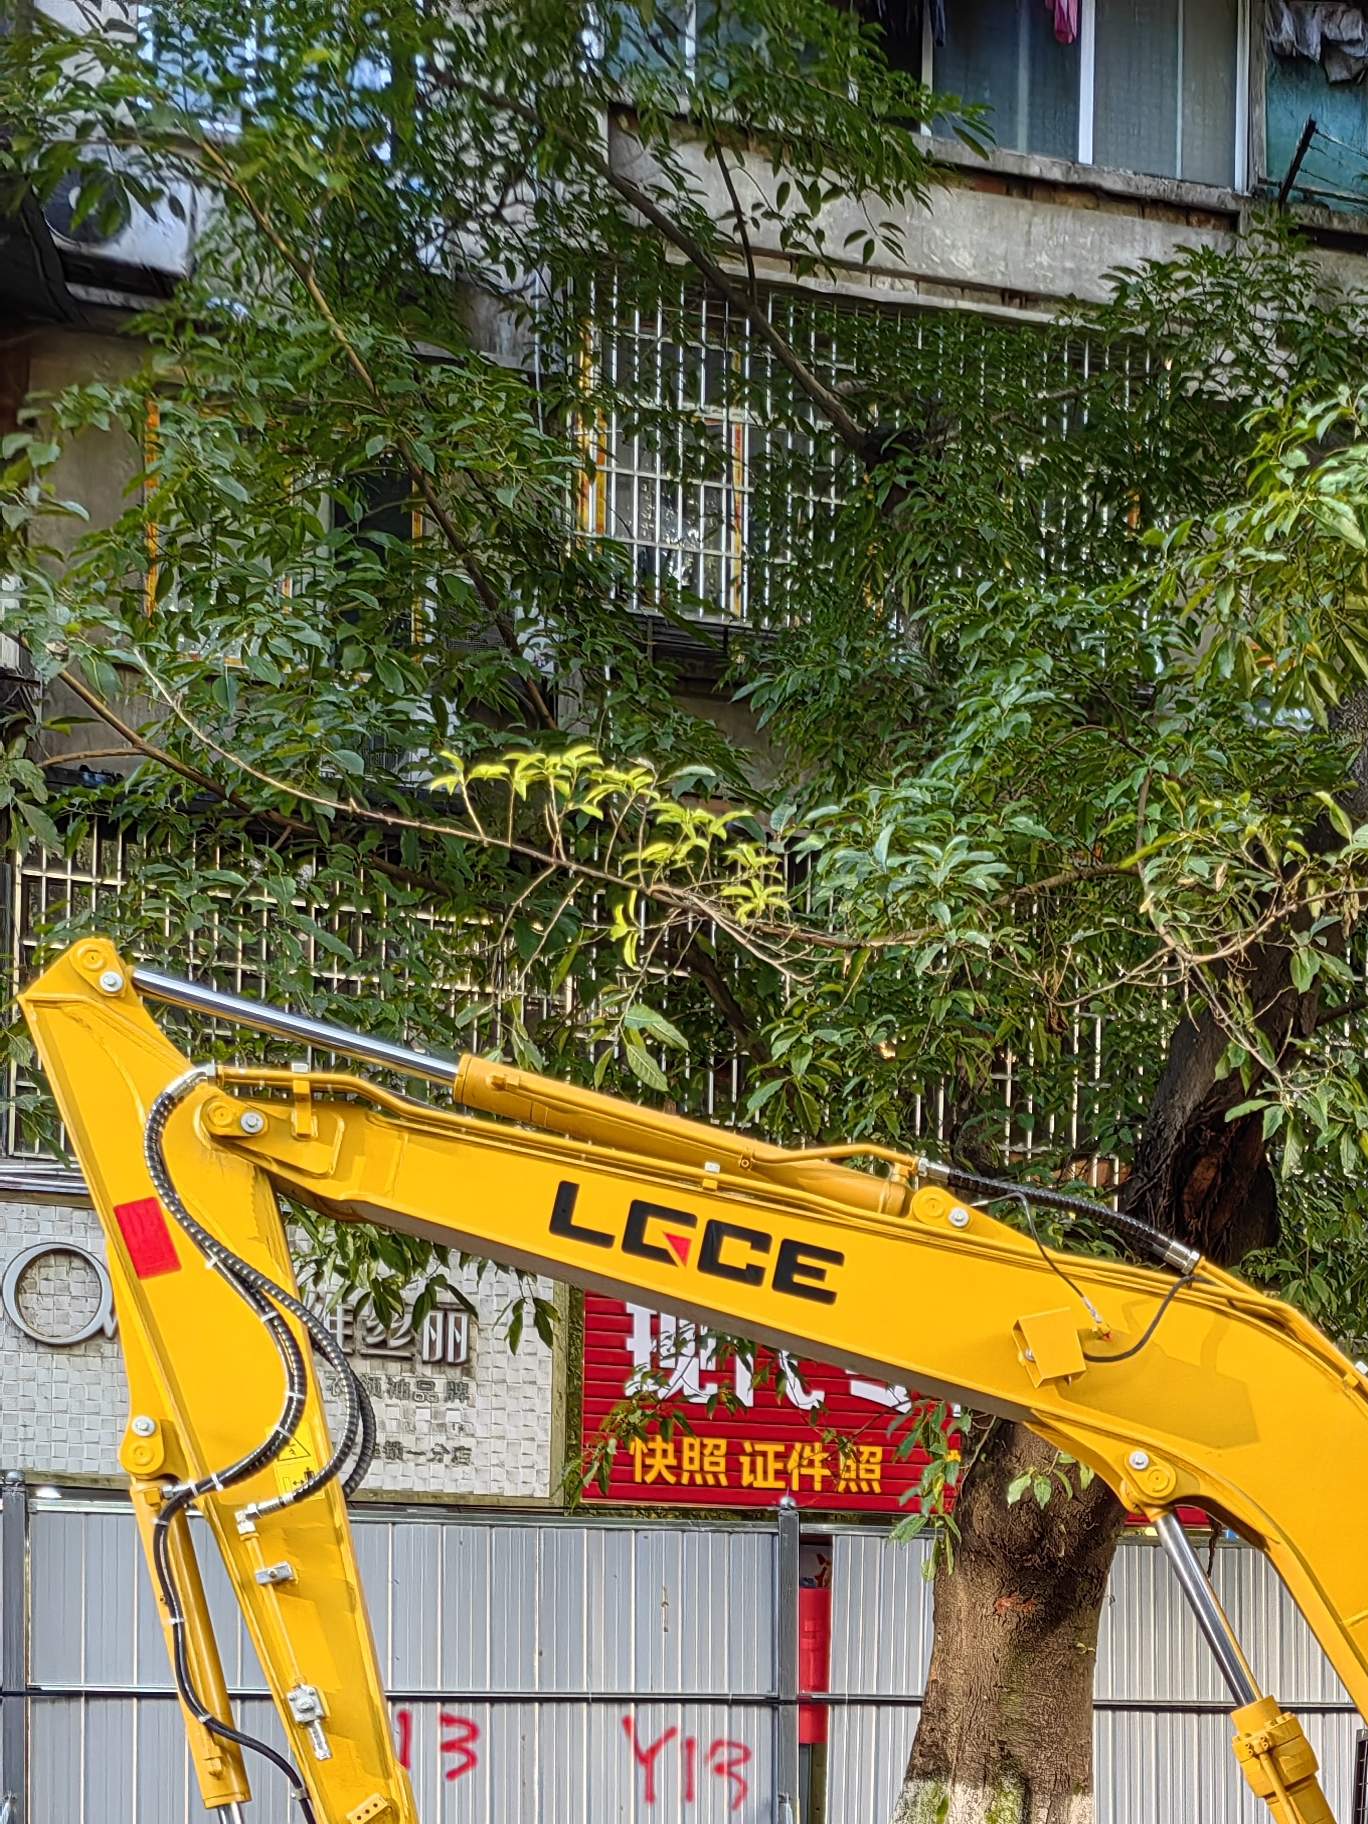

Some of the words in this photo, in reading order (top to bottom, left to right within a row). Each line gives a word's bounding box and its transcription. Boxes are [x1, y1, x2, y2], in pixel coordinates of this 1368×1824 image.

[630, 1437, 728, 1487] 快照
[739, 1441, 884, 1493] 证件照
